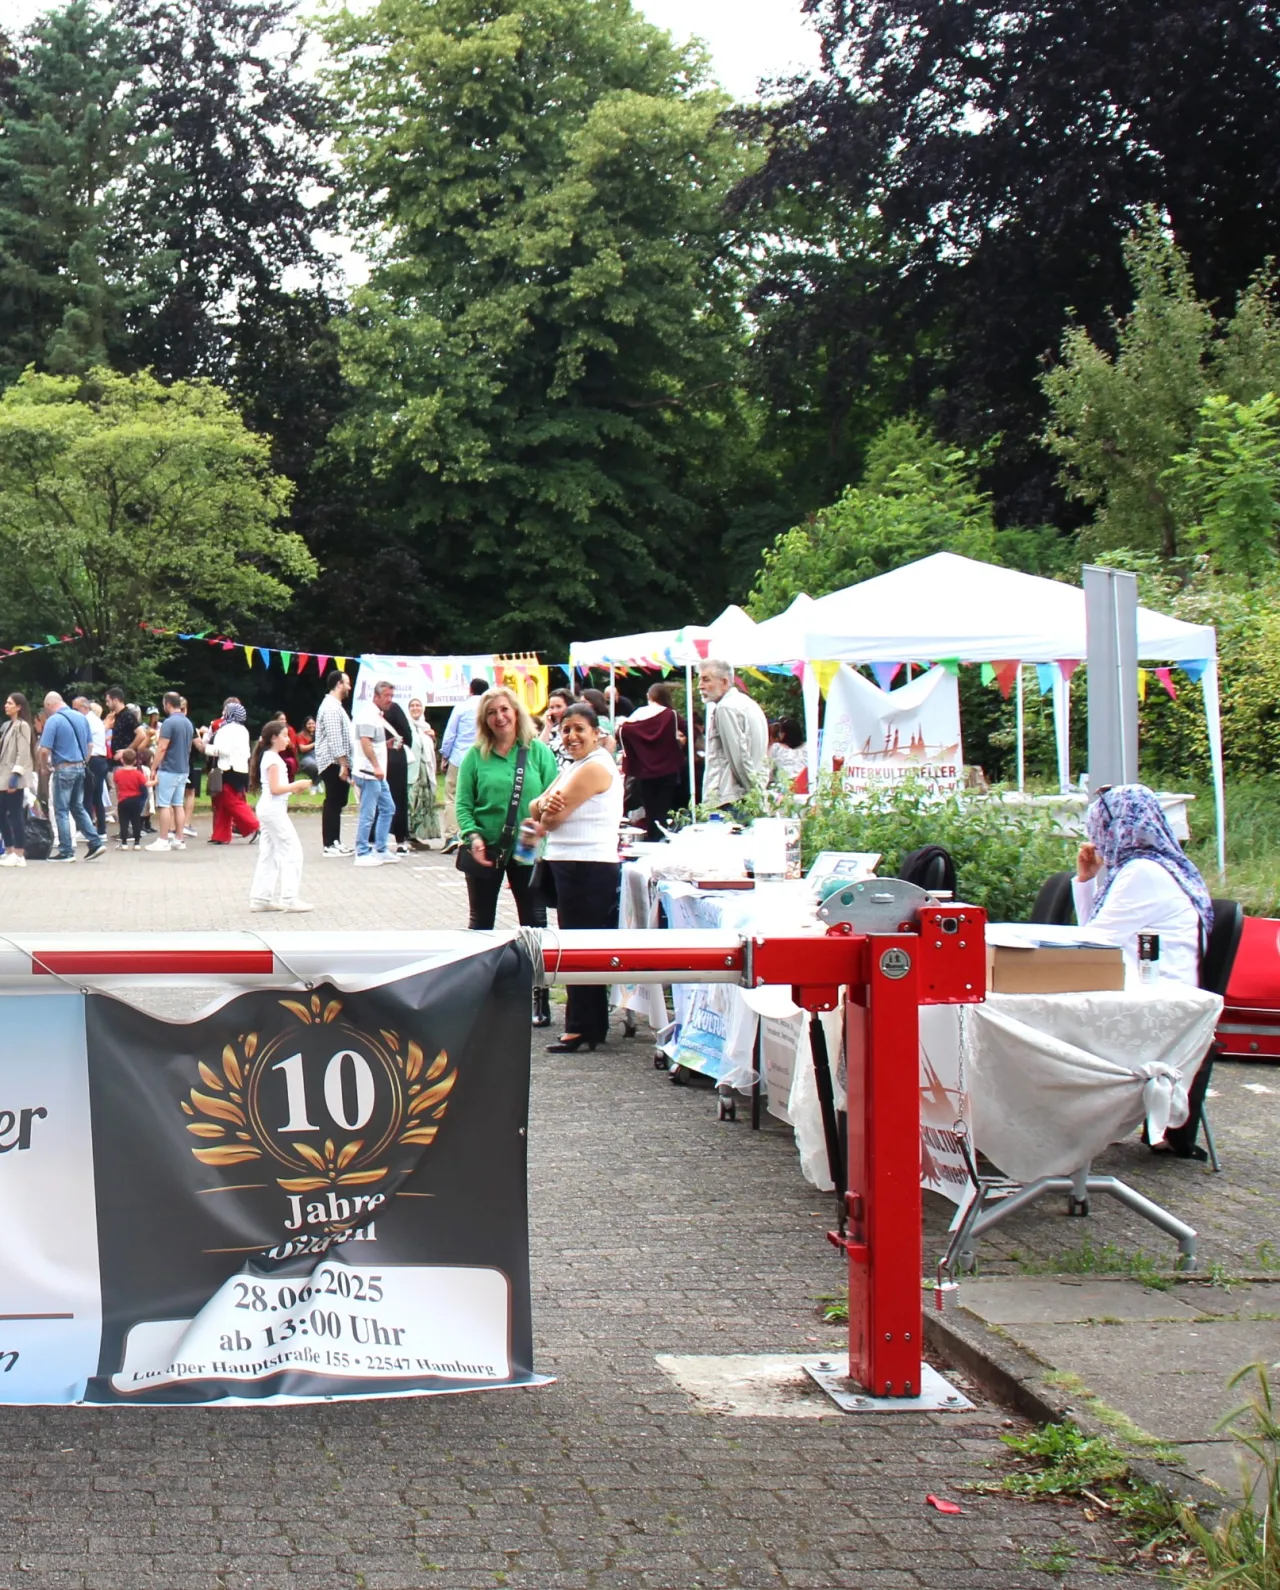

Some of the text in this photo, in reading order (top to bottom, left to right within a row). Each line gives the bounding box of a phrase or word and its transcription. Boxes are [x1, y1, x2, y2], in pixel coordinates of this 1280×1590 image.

[271, 1049, 376, 1133] 10
[283, 1191, 386, 1230] Jahre
[220, 1308, 407, 1351] ab 13:00 Uhr
[211, 1346, 320, 1376] Hauptstraße
[325, 1350, 351, 1368] 155
[365, 1355, 411, 1371] 22547
[415, 1358, 497, 1377] Hamburg
